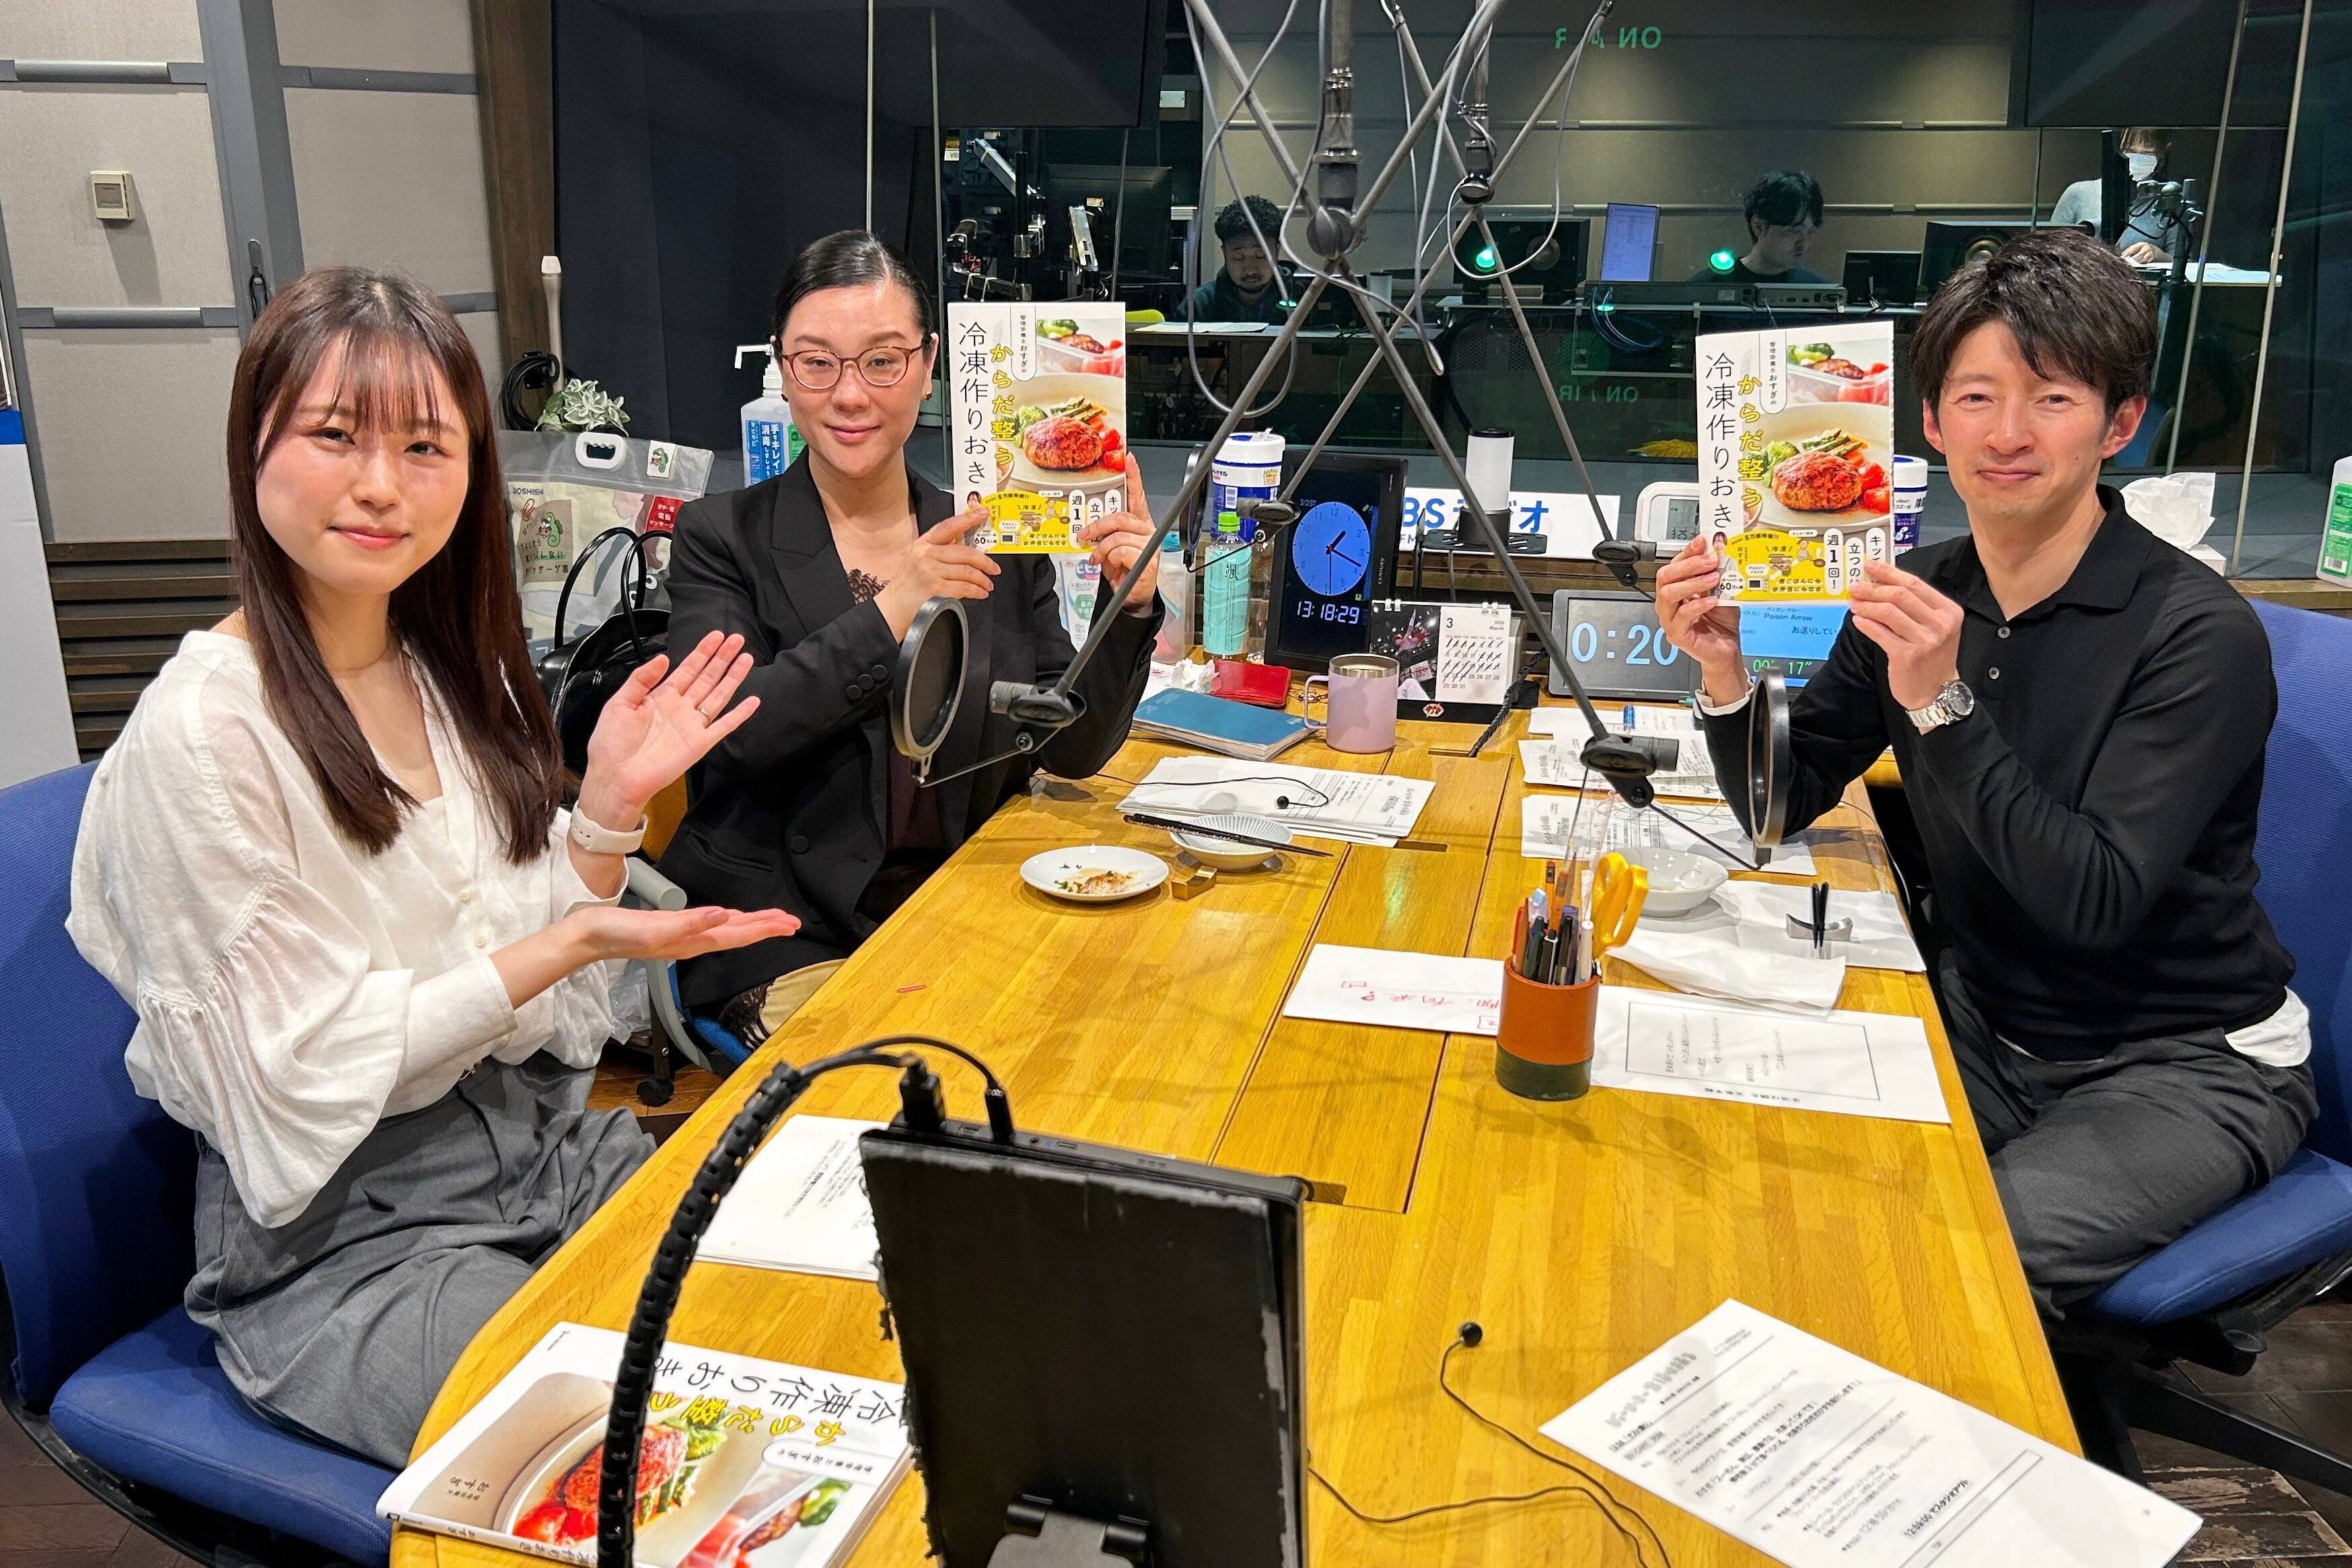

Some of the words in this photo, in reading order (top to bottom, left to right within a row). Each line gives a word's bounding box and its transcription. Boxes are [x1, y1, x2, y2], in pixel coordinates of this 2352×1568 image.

[959, 322, 989, 484] 冷凍作りおき
[991, 344, 1016, 466] からだ整う
[1705, 352, 1736, 529] 冷凍作りおき
[1738, 373, 1764, 509] からだ整う
[1330, 508, 1339, 517] 12
[1303, 524, 1312, 532] 10
[1356, 530, 1362, 538] 2
[1298, 542, 1303, 550] 9
[1359, 548, 1364, 557] 3
[1300, 561, 1306, 569] 8
[1826, 535, 1840, 590] 週1回!
[1324, 582, 1330, 591] 6
[1340, 579, 1345, 587] 5
[1297, 600, 1360, 625] 13:18:29
[1446, 617, 1454, 629] 3
[652, 1356, 905, 1427] 冷凍作りおき
[649, 1391, 845, 1447] からだ整う
